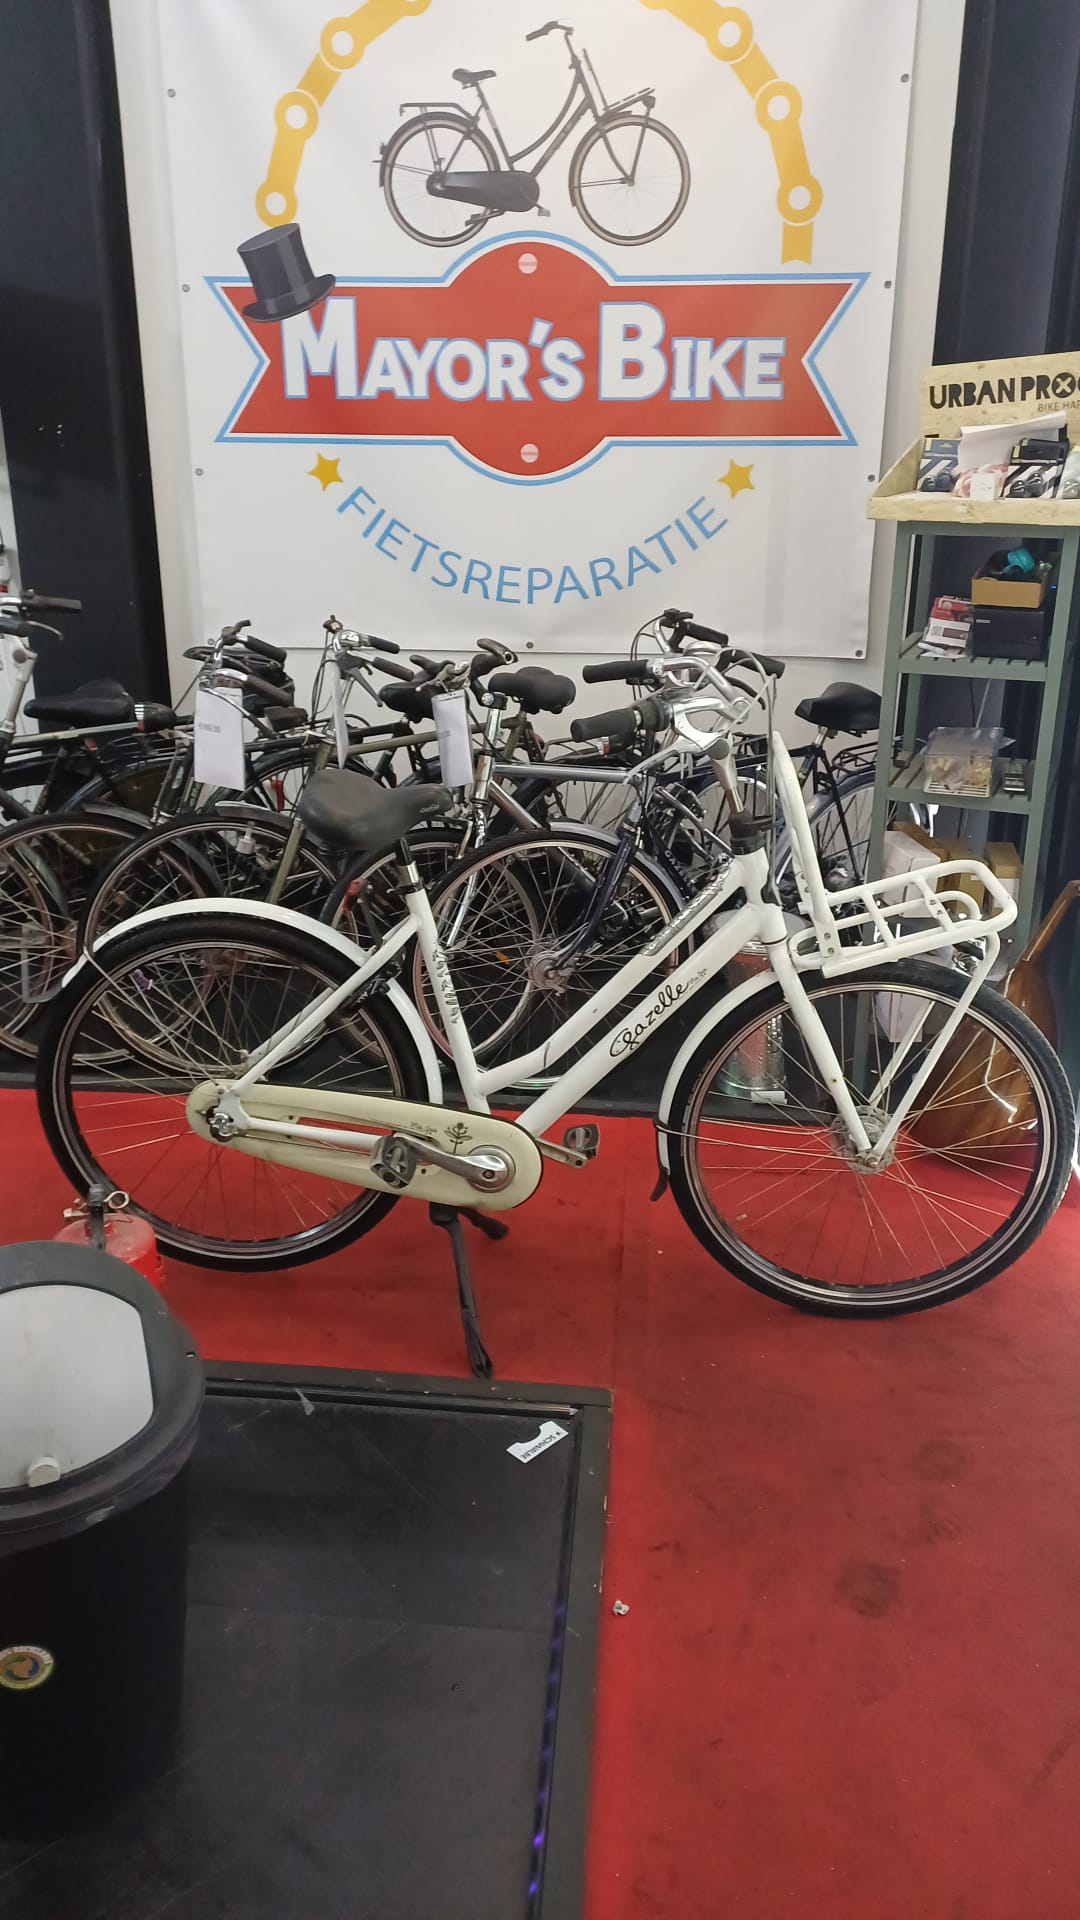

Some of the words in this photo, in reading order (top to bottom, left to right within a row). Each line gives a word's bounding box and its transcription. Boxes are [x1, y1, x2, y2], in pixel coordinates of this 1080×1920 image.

[598, 300, 786, 401] BIKE
[929, 377, 1016, 409] URBAN
[1020, 372, 1080, 402] PRO
[1037, 401, 1059, 413] BIKE
[336, 486, 729, 605] FIETSREPARATIE
[609, 983, 690, 1057] Gazelle
